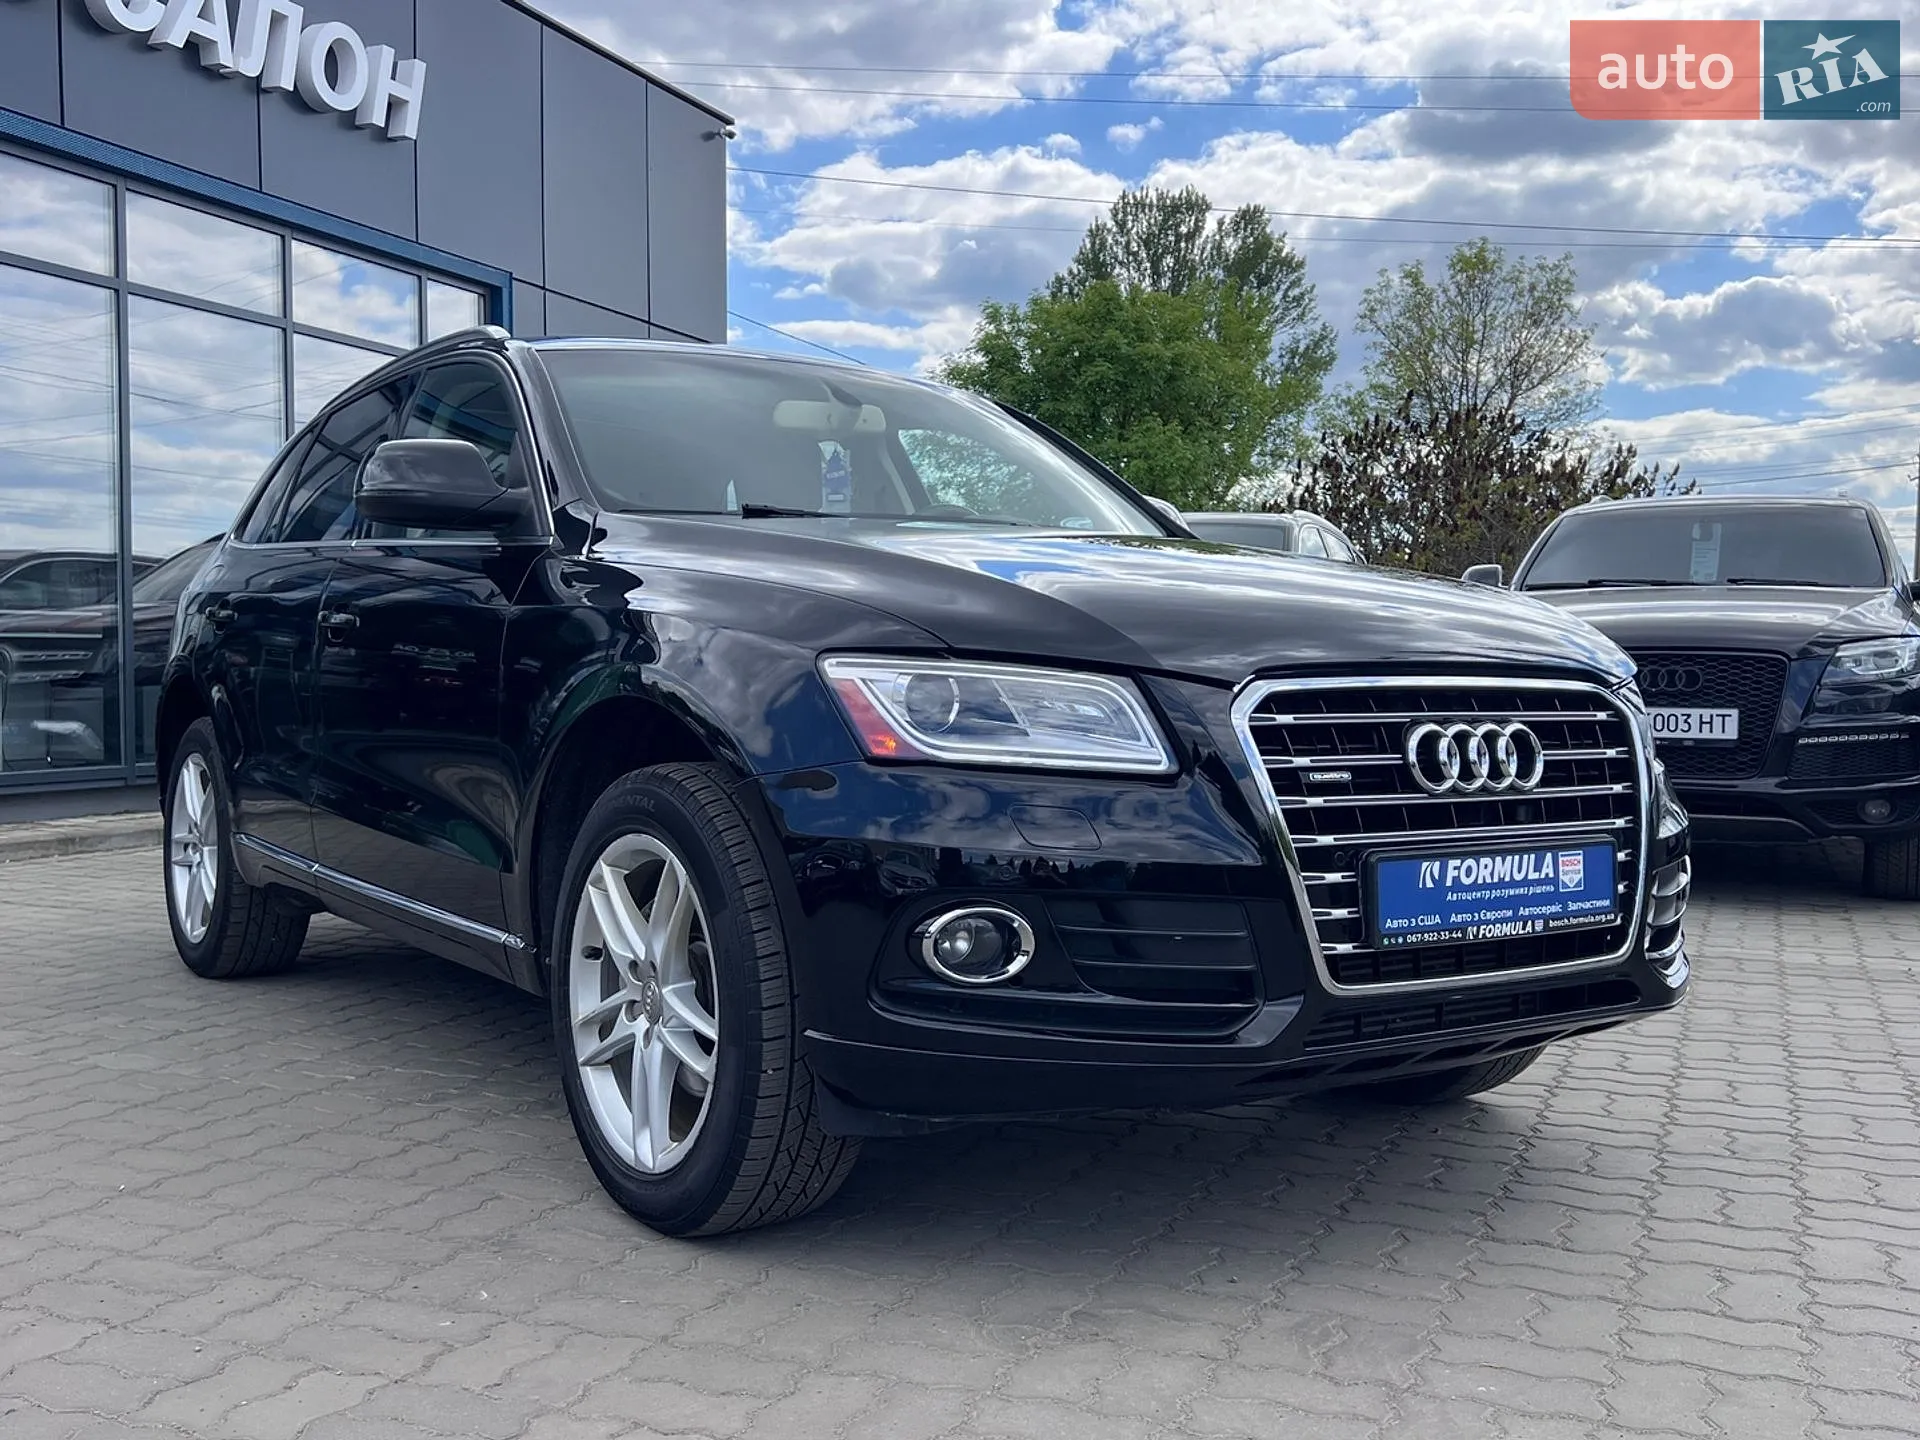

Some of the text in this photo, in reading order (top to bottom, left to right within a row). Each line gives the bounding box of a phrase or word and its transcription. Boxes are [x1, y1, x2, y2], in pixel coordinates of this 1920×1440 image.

[1646, 713, 1732, 734] 003 HT
[1446, 852, 1554, 886] FORMULA
[1561, 858, 1581, 868] BOSCH
[1385, 918, 1409, 929] Авто
[1418, 914, 1441, 926] США
[1450, 912, 1472, 923] Авто
[1478, 920, 1533, 939] FORMULA
